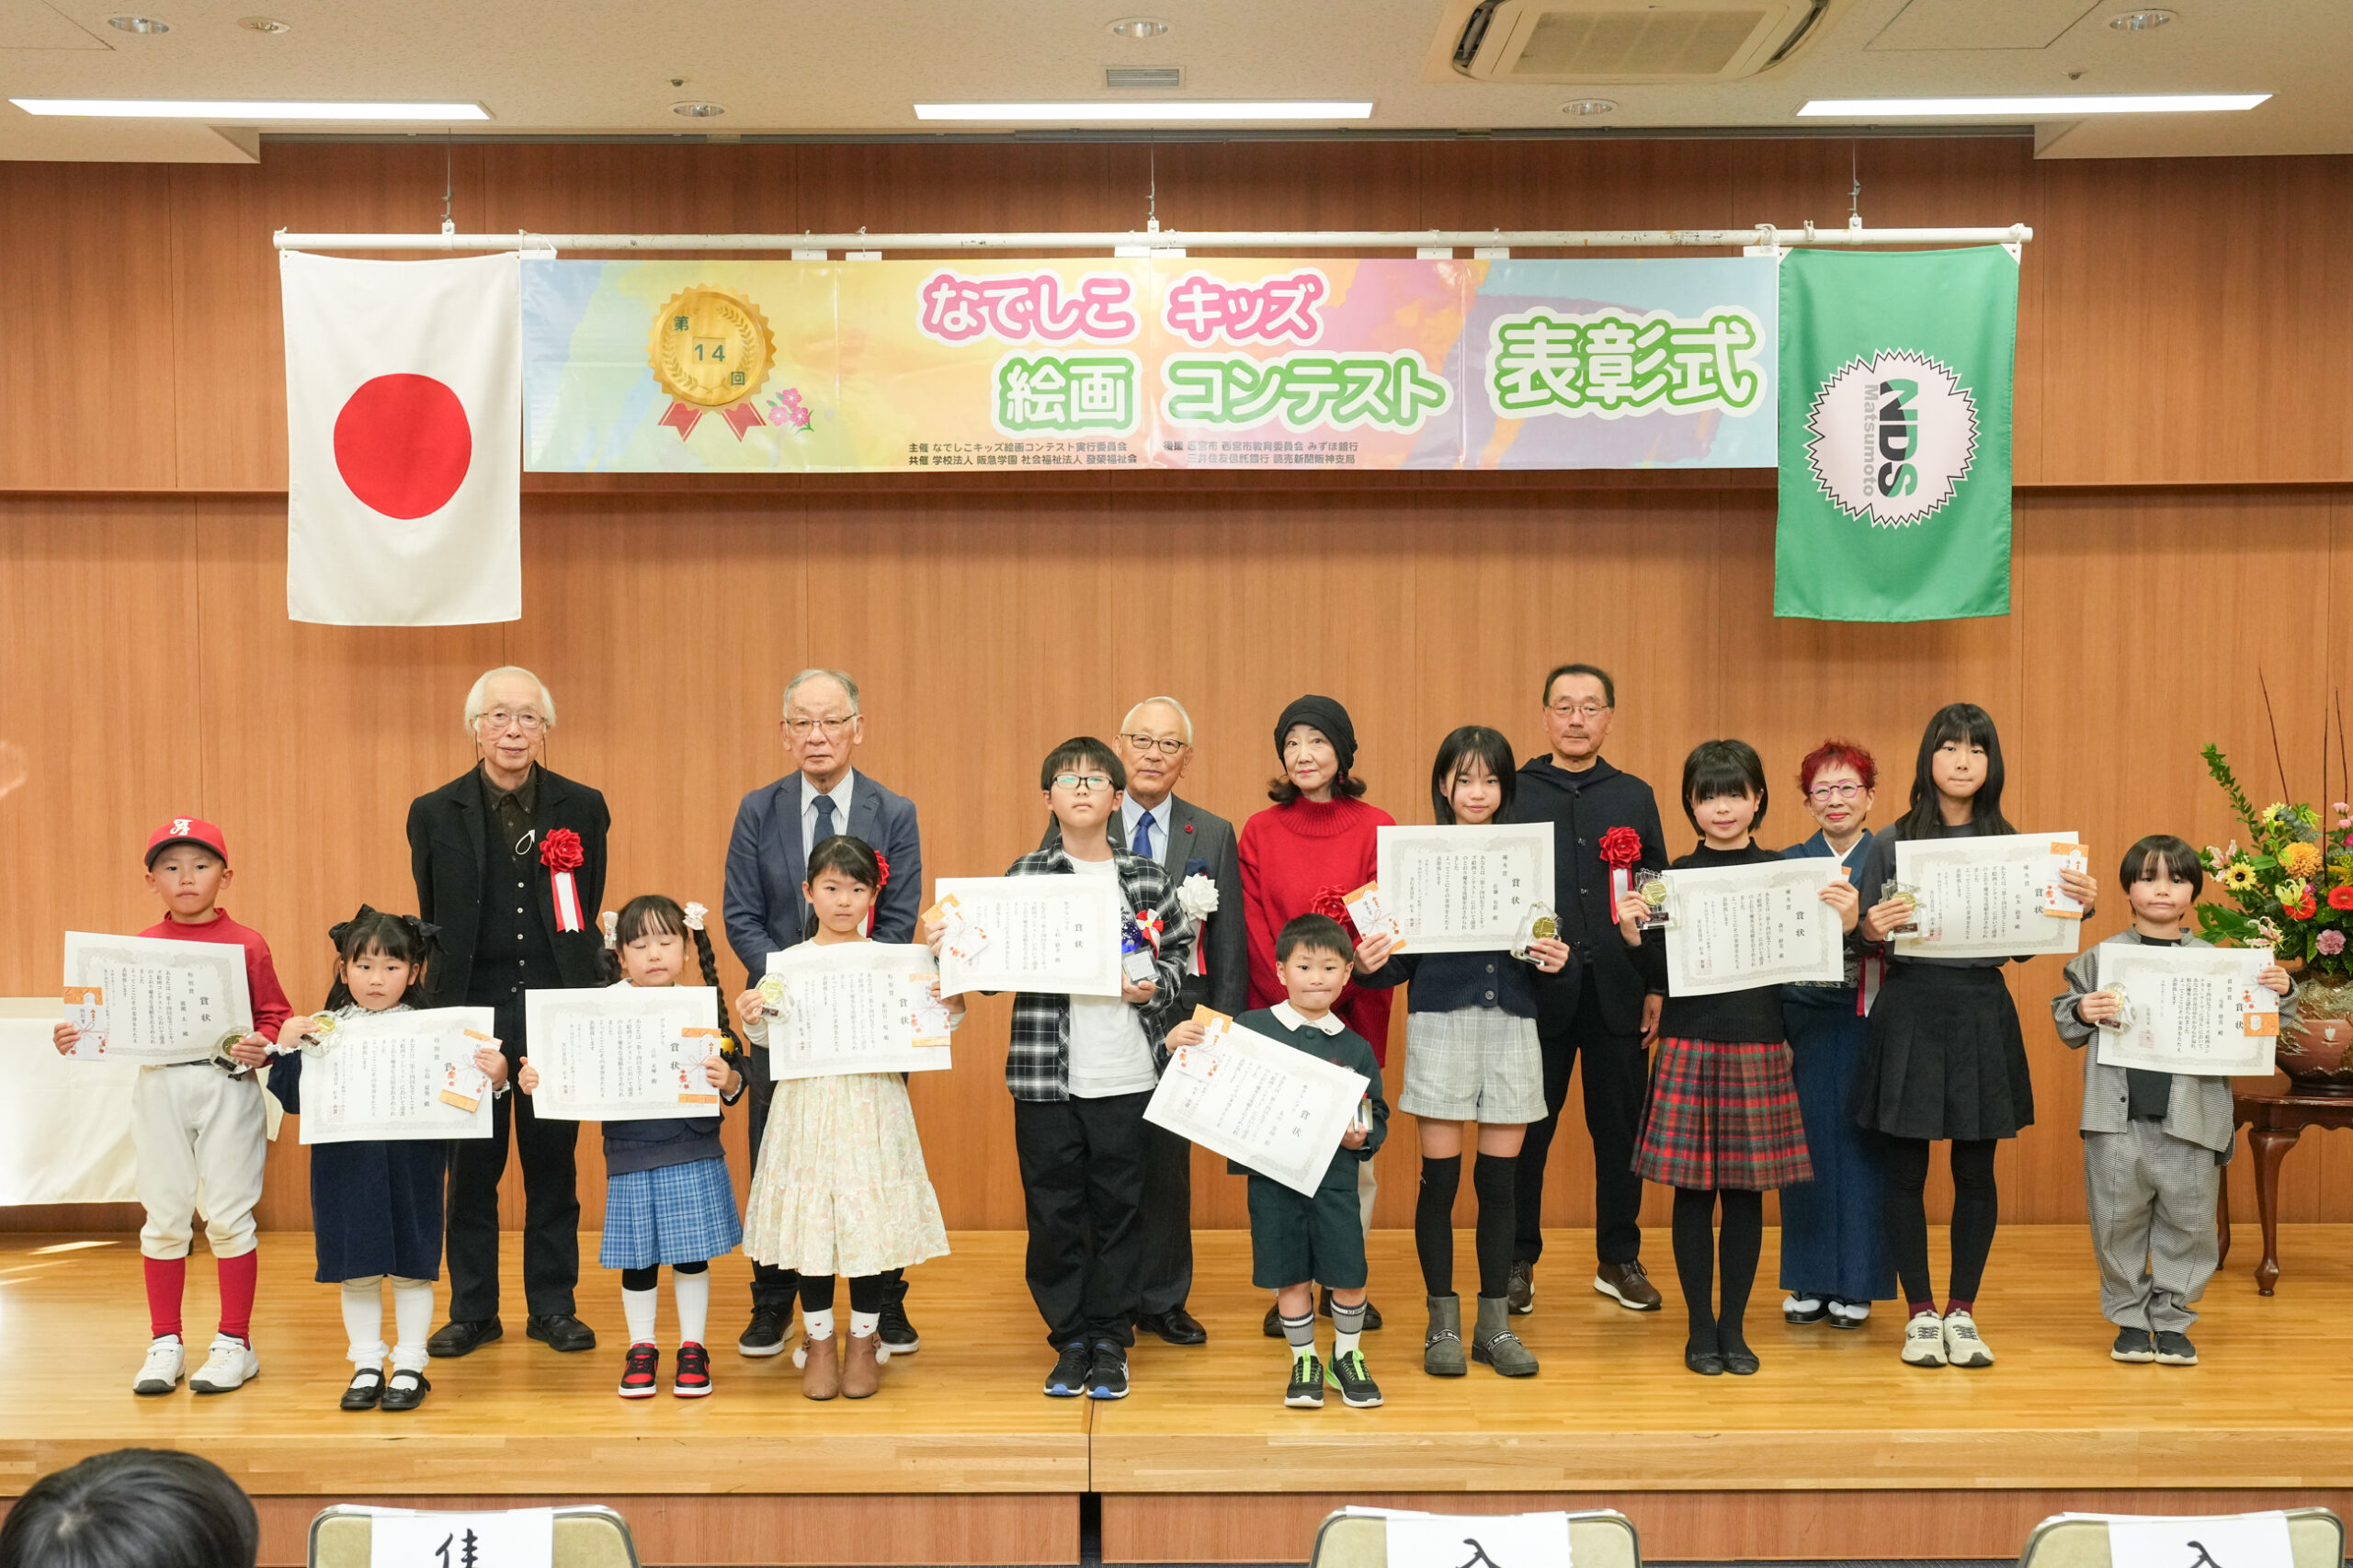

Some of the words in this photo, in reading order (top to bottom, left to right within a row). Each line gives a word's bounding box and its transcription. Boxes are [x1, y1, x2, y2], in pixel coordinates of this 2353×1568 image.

[922, 274, 1136, 339] なでしこ
[1168, 275, 1322, 341] キッズ
[674, 315, 689, 332] 第
[694, 344, 726, 362] 14
[731, 370, 745, 386] 回
[1497, 314, 1758, 412] 表彰式
[998, 357, 1135, 432] 絵画
[1169, 357, 1446, 426] コンテスト
[908, 442, 929, 452] 主催
[932, 441, 1128, 452] なでしこキッズ絵画コンテスト実行委員会
[1307, 441, 1359, 451] みずほ銀行
[1863, 384, 1879, 497] Matsumoto
[1878, 378, 1918, 498] NDS
[908, 455, 929, 466] 共催
[932, 455, 973, 465] 学校法人
[976, 455, 1018, 465] 阪急学園
[1021, 454, 1083, 465] 社会福祉法人
[1188, 453, 1269, 463] 三井住友信託銀行
[1273, 453, 1356, 464] 読売新聞阪神支局
[1511, 878, 1521, 905] 賞状
[2034, 888, 2044, 915] 賞状
[1795, 911, 1805, 937] 賞状
[199, 995, 211, 1023] 賞状
[2234, 1003, 2245, 1030] 賞状
[670, 1041, 680, 1071] 賞状
